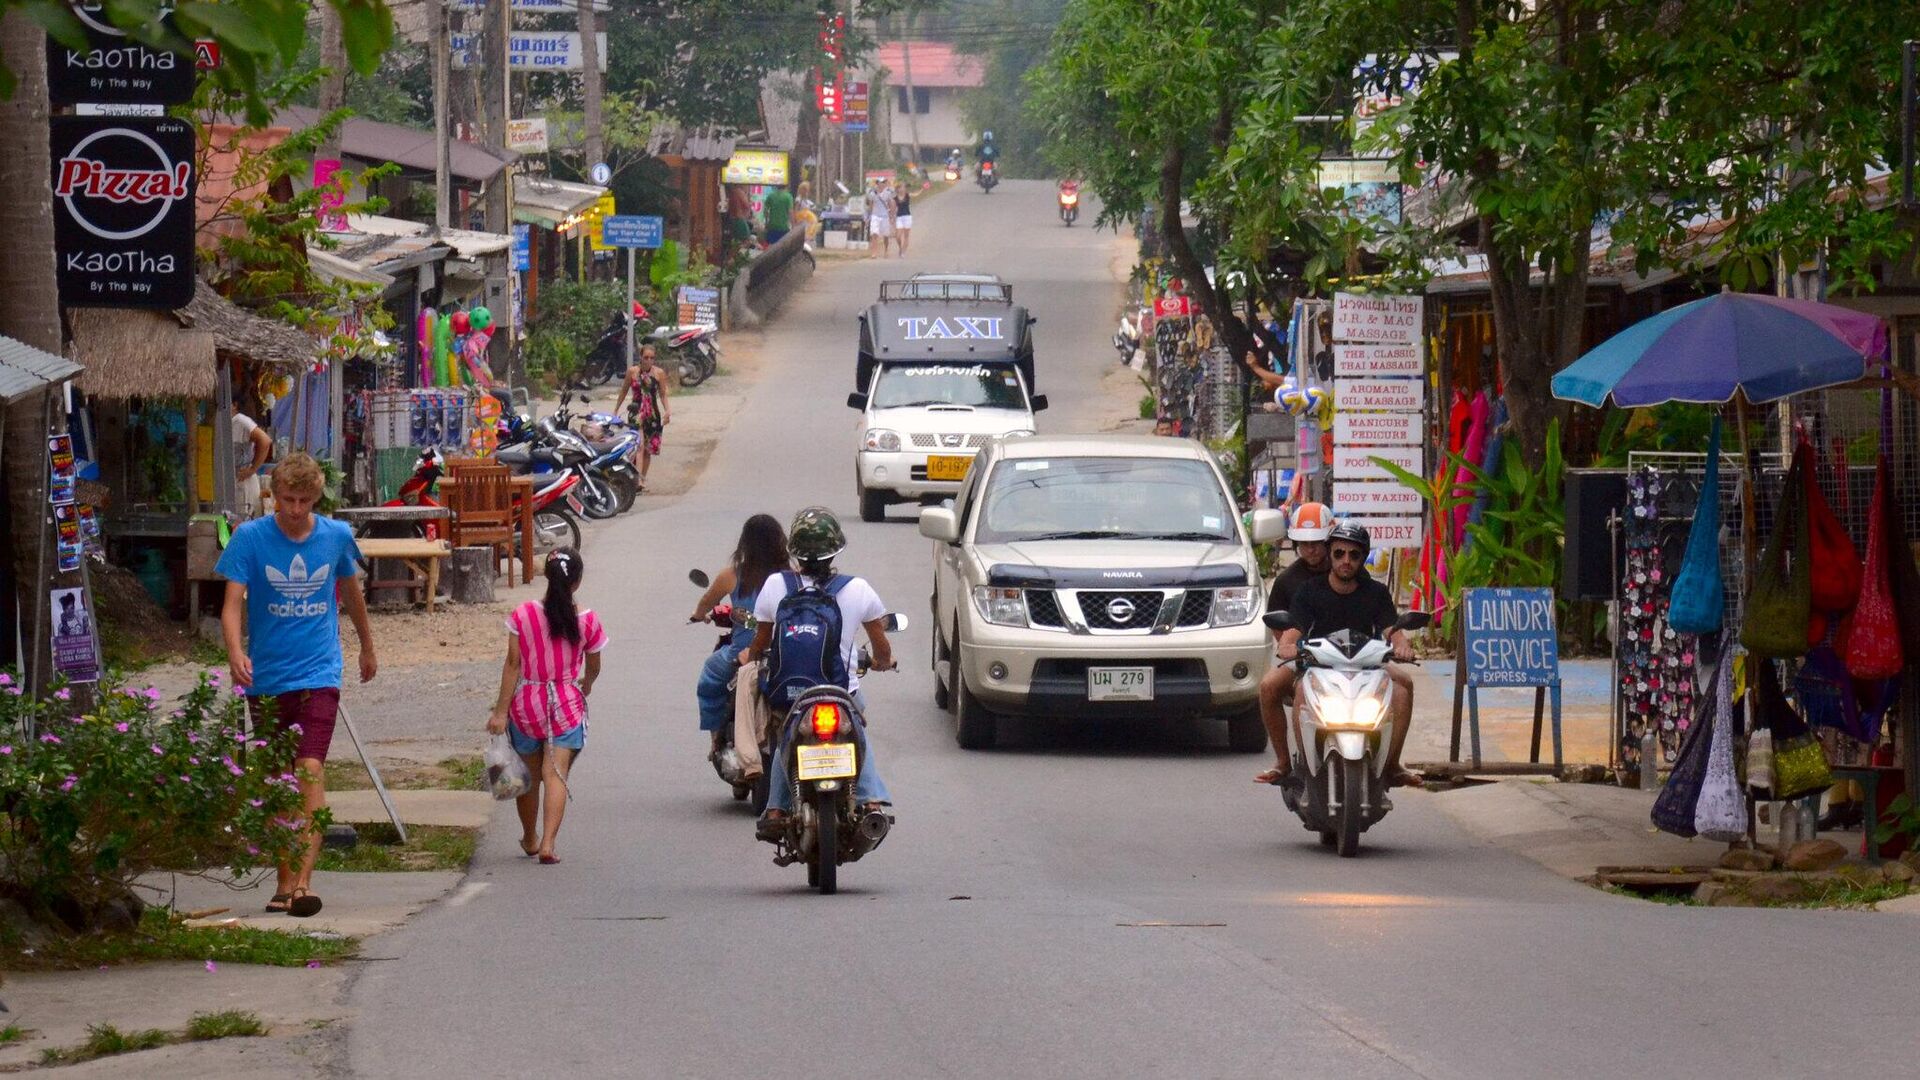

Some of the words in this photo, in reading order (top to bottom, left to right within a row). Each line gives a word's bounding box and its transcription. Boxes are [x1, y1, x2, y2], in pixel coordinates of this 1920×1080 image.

[66, 47, 175, 69] KaoTha
[533, 55, 568, 65] CAPE
[91, 78, 104, 90] By
[109, 78, 127, 88] The
[132, 79, 152, 91] Way
[55, 157, 190, 203] Pizza!
[66, 250, 175, 273] KaoTha
[90, 282, 103, 293] By
[109, 282, 127, 291] The
[132, 282, 152, 294] Way
[1384, 315, 1414, 326] MAC
[898, 316, 1004, 340] TAXI
[1346, 328, 1407, 339] MASSAGE
[1374, 350, 1416, 358] CLASSIC
[1340, 362, 1366, 370] THAI
[1370, 361, 1418, 370] MASSAGE
[1350, 385, 1409, 393] AROMATIC
[1342, 397, 1360, 405] OIL
[1364, 397, 1417, 405] MASSAGE
[1349, 419, 1409, 427] MANICURE
[1351, 431, 1407, 439] PEDICURE
[1345, 459, 1370, 467] FOOT
[1338, 493, 1367, 502] BODY
[1372, 493, 1418, 502] WAXING
[268, 600, 328, 617] adidas
[1468, 599, 1553, 631] LAUNDRY
[1472, 638, 1552, 670] SERVICE
[1121, 672, 1144, 685] 279
[1483, 671, 1527, 683] EXPRESS
